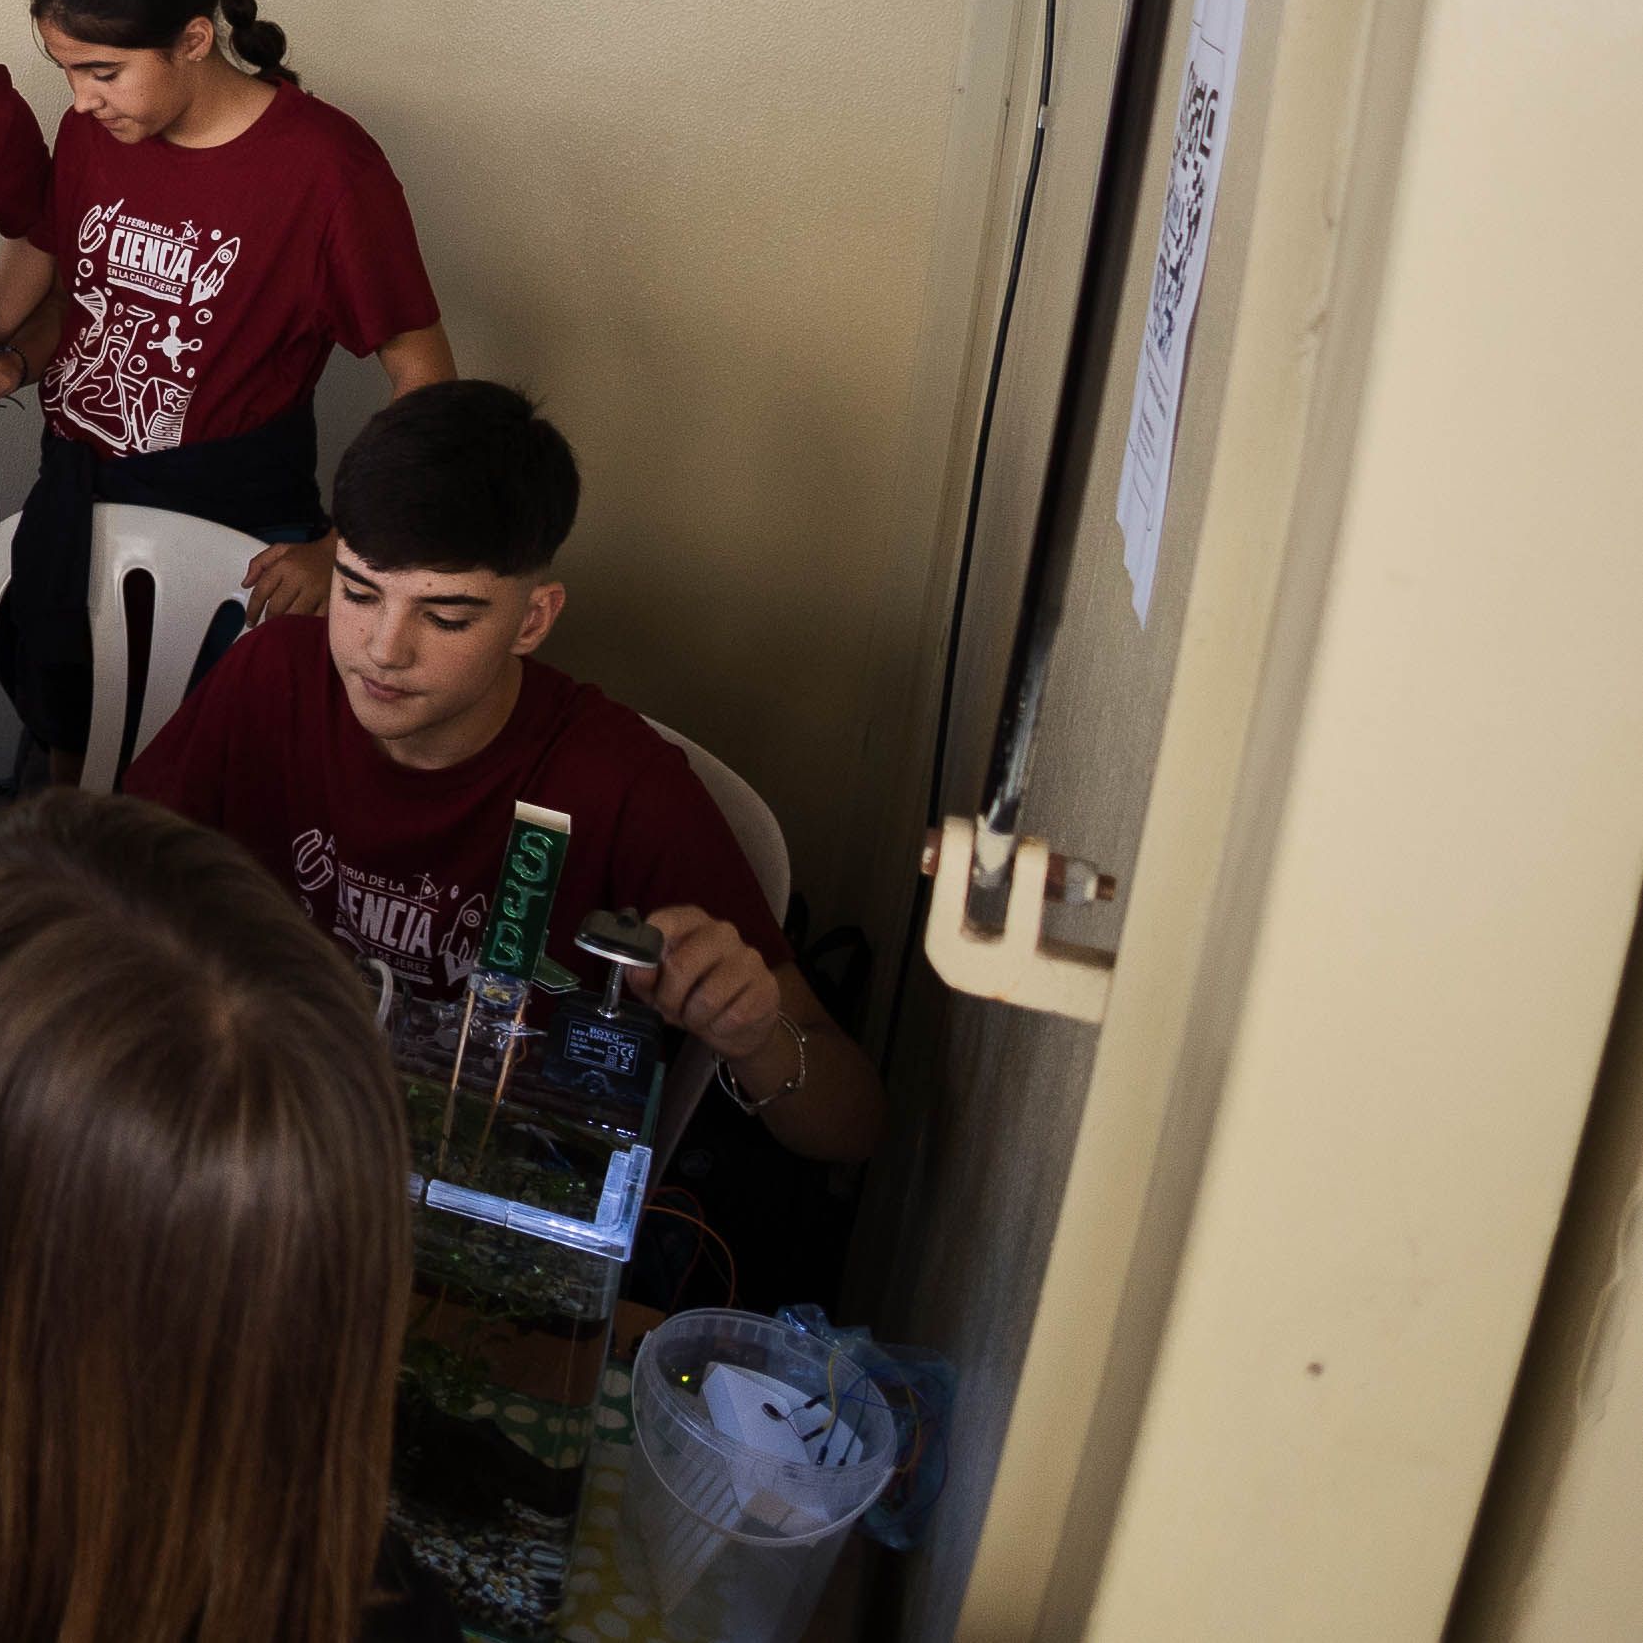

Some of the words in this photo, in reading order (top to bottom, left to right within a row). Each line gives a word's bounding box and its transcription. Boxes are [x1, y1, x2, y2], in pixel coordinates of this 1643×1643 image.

[117, 214, 126, 224] XI
[126, 216, 150, 231] FERIA
[150, 222, 162, 234] DE
[162, 227, 174, 237] LA
[107, 228, 193, 284] CIENCIA
[107, 267, 118, 277] EN
[118, 269, 129, 279] LA
[369, 875, 386, 889] DE
[388, 880, 405, 894] LA
